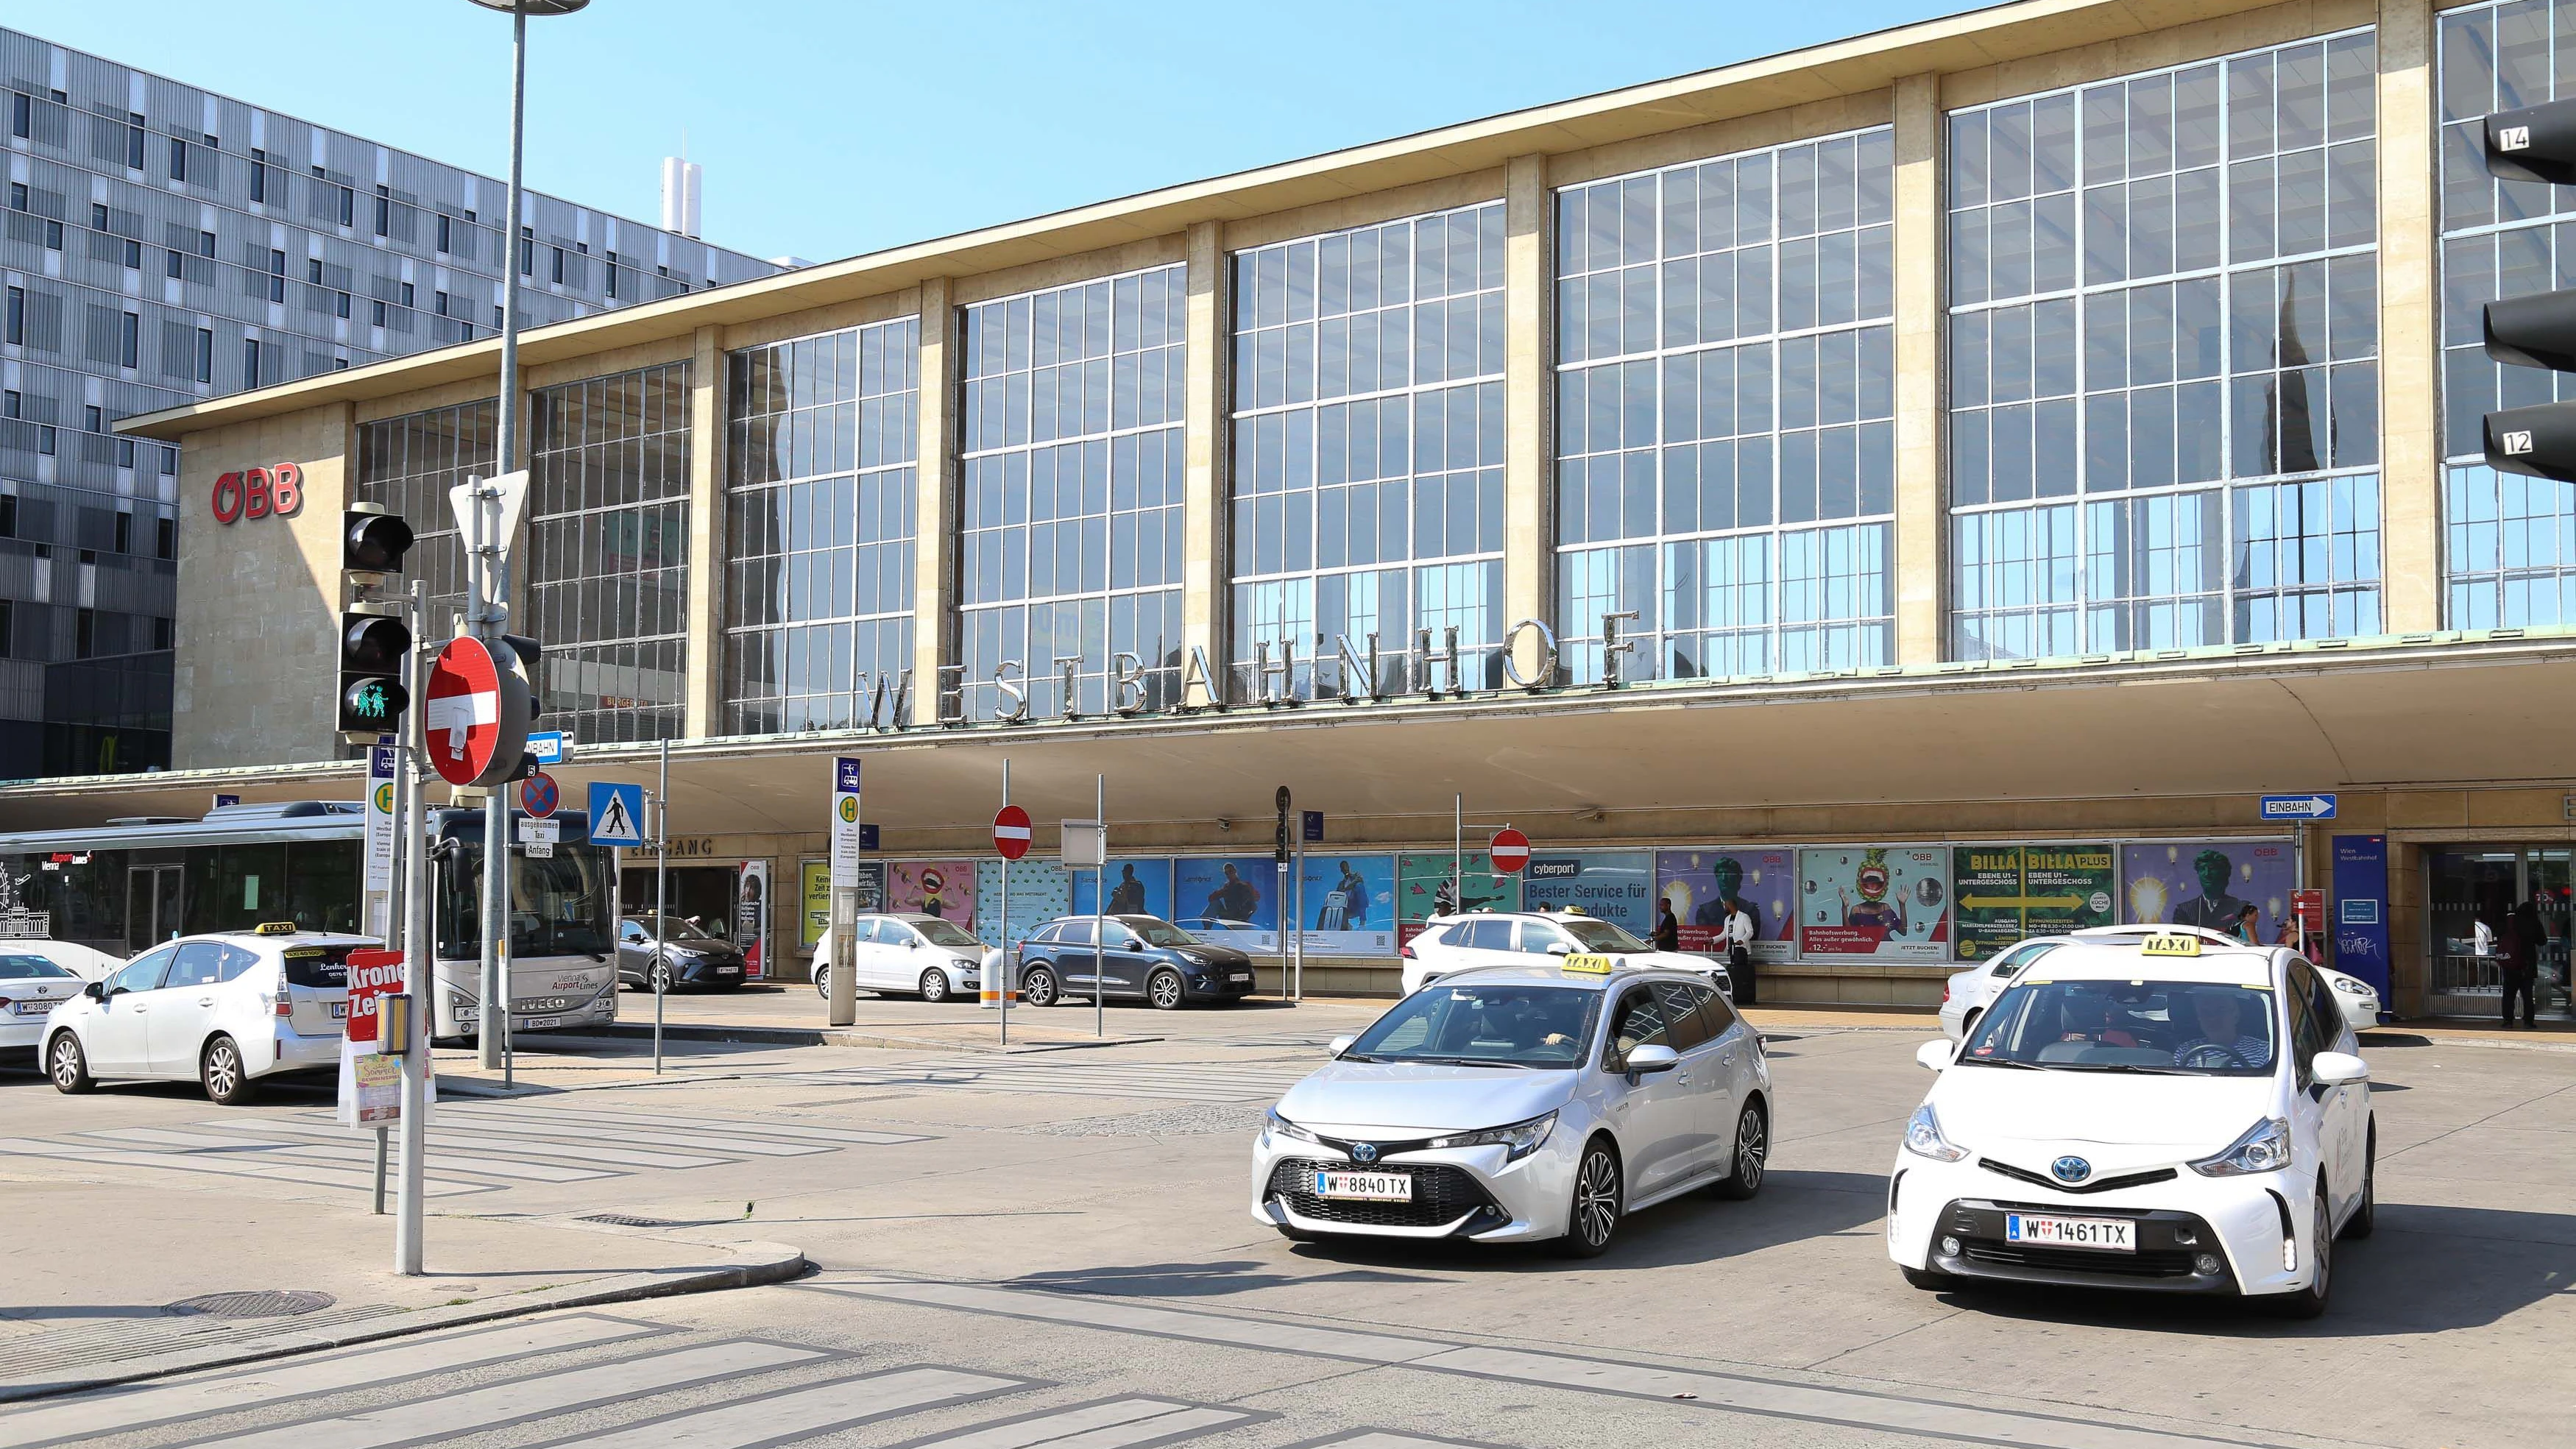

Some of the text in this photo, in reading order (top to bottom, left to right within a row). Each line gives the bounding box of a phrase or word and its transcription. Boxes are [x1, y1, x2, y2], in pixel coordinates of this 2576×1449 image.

[2503, 127, 2527, 148] 14
[2508, 433, 2530, 453] 12
[212, 462, 302, 524] ÖBB
[857, 610, 1640, 733] WESTBAHNHOF
[527, 741, 554, 755] NBAHN
[528, 766, 535, 776] 5
[845, 801, 854, 818] H
[2270, 801, 2311, 812] EINBAHN
[520, 821, 558, 830] ausgenommen
[534, 830, 545, 839] Taxi
[528, 845, 550, 857] Anfang
[1912, 852, 1932, 861] ÖBB
[52, 852, 88, 865] Airport Lines
[1971, 854, 2017, 869] BILLA
[2028, 854, 2108, 869] BILLA PLUS
[42, 860, 59, 871] Vienna
[1534, 863, 1574, 876] cyberport
[1529, 883, 1646, 899] Bester Service für
[1585, 903, 1627, 917] odukte
[2148, 938, 2190, 951] TAXI
[1566, 957, 1602, 969] TAXI
[347, 962, 405, 990] Krone
[557, 974, 580, 982] Vienna
[552, 981, 598, 991] Airport Lines
[34, 1002, 52, 1010] 3080
[521, 998, 565, 1010] IVECO
[543, 1018, 556, 1027] 2021
[364, 1064, 396, 1077] Sommer
[1328, 1176, 1337, 1191] W
[1349, 1177, 1385, 1193] 8840
[1389, 1178, 1406, 1194] TX
[2026, 1219, 2039, 1239] W
[2055, 1222, 2097, 1242] 1461
[2103, 1225, 2126, 1244] TX
